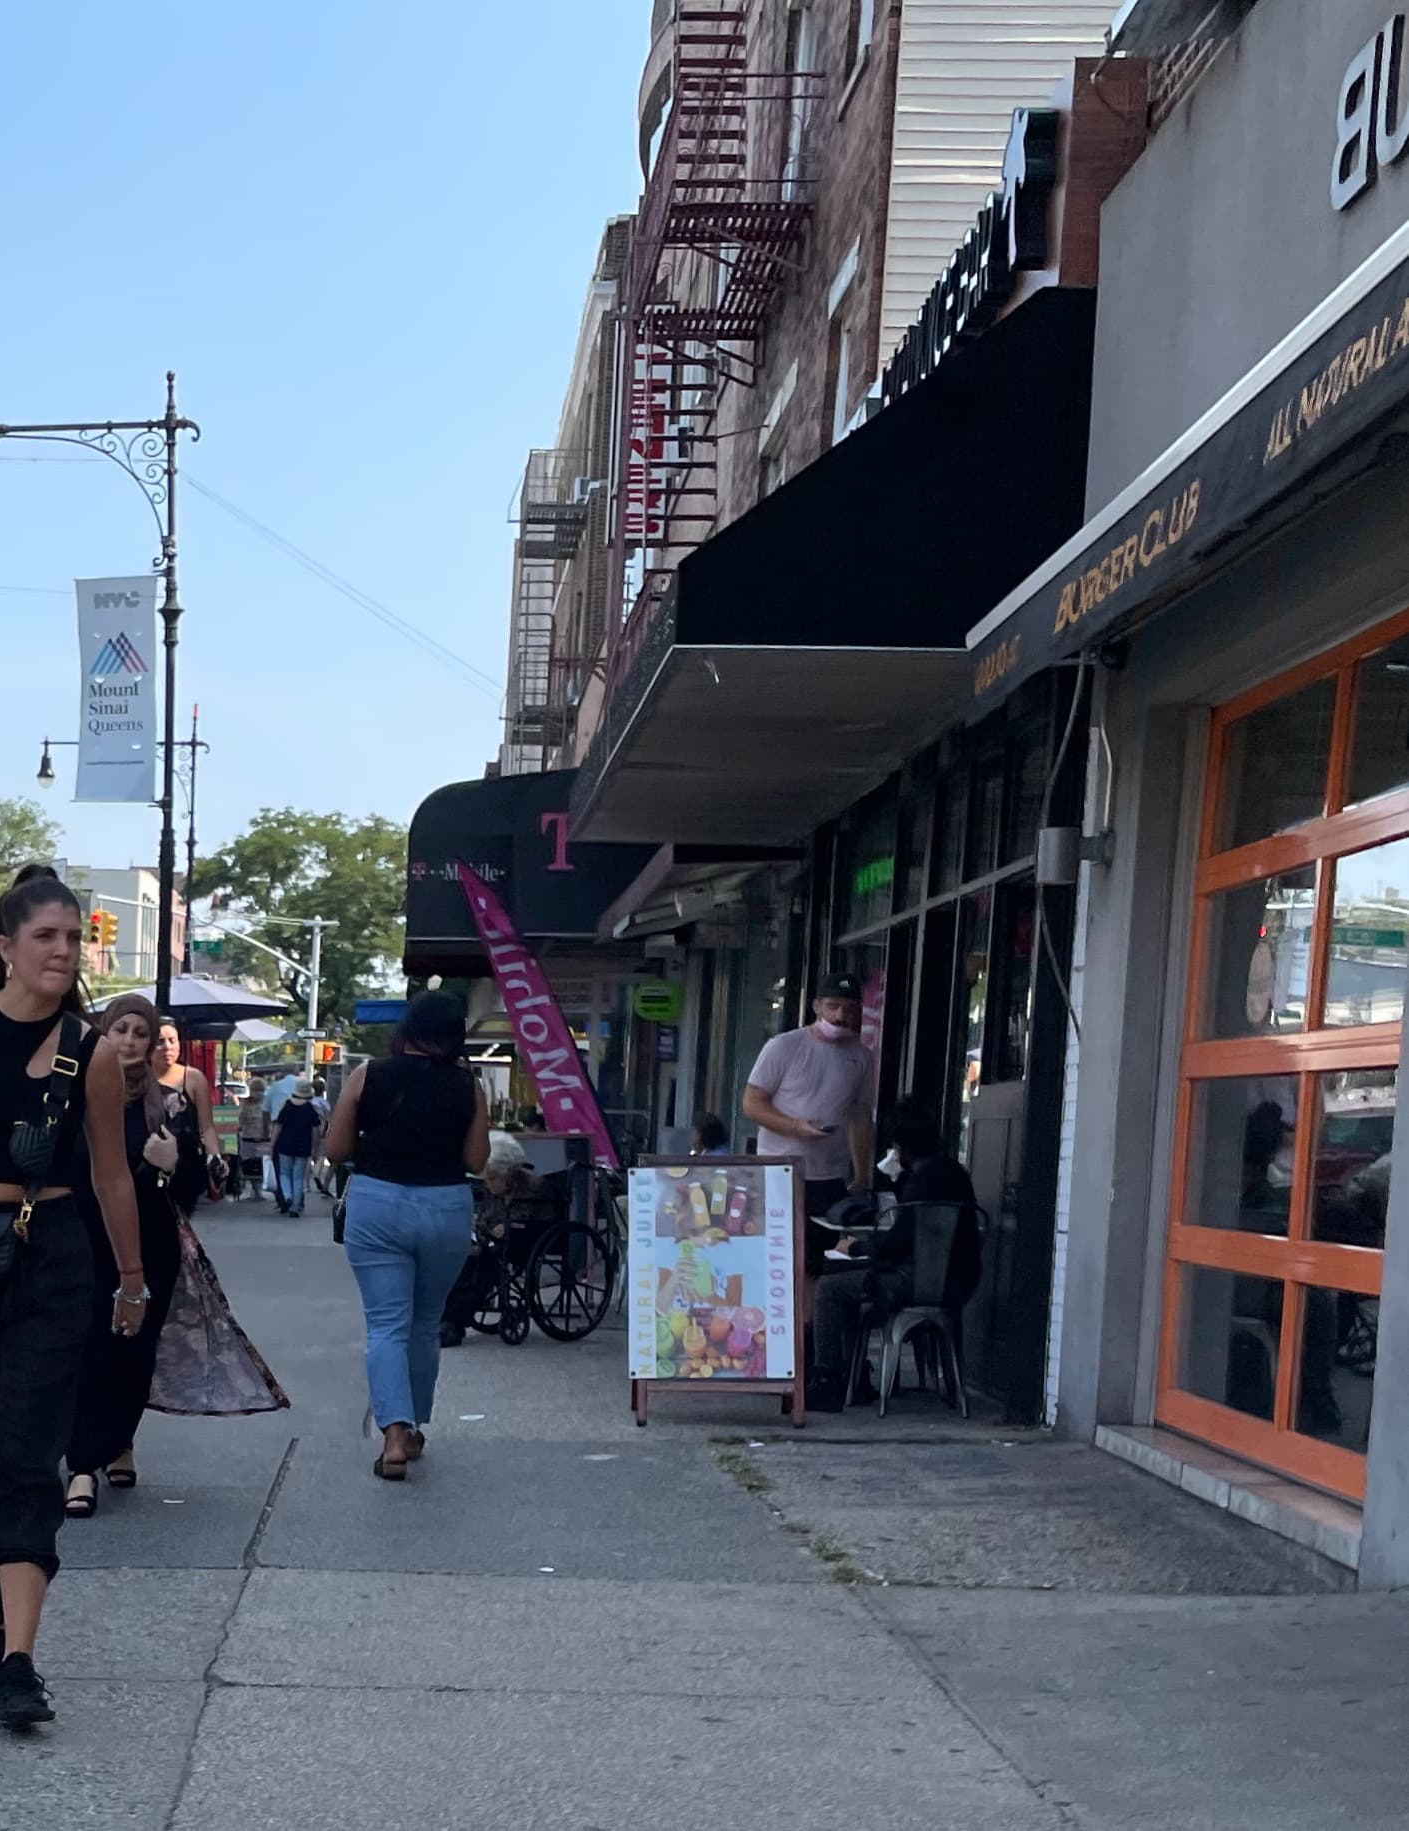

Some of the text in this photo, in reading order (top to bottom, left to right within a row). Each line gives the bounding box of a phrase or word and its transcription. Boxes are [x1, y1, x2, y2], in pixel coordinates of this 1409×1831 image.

[94, 591, 141, 609] NYC
[88, 682, 139, 698] Mount
[88, 701, 129, 715] Sinai
[88, 719, 144, 736] Queens
[540, 812, 574, 871] T
[636, 1174, 653, 1249] JUICE
[769, 1207, 786, 1337] SMOOTHIE
[638, 1263, 653, 1375] NATURAL
